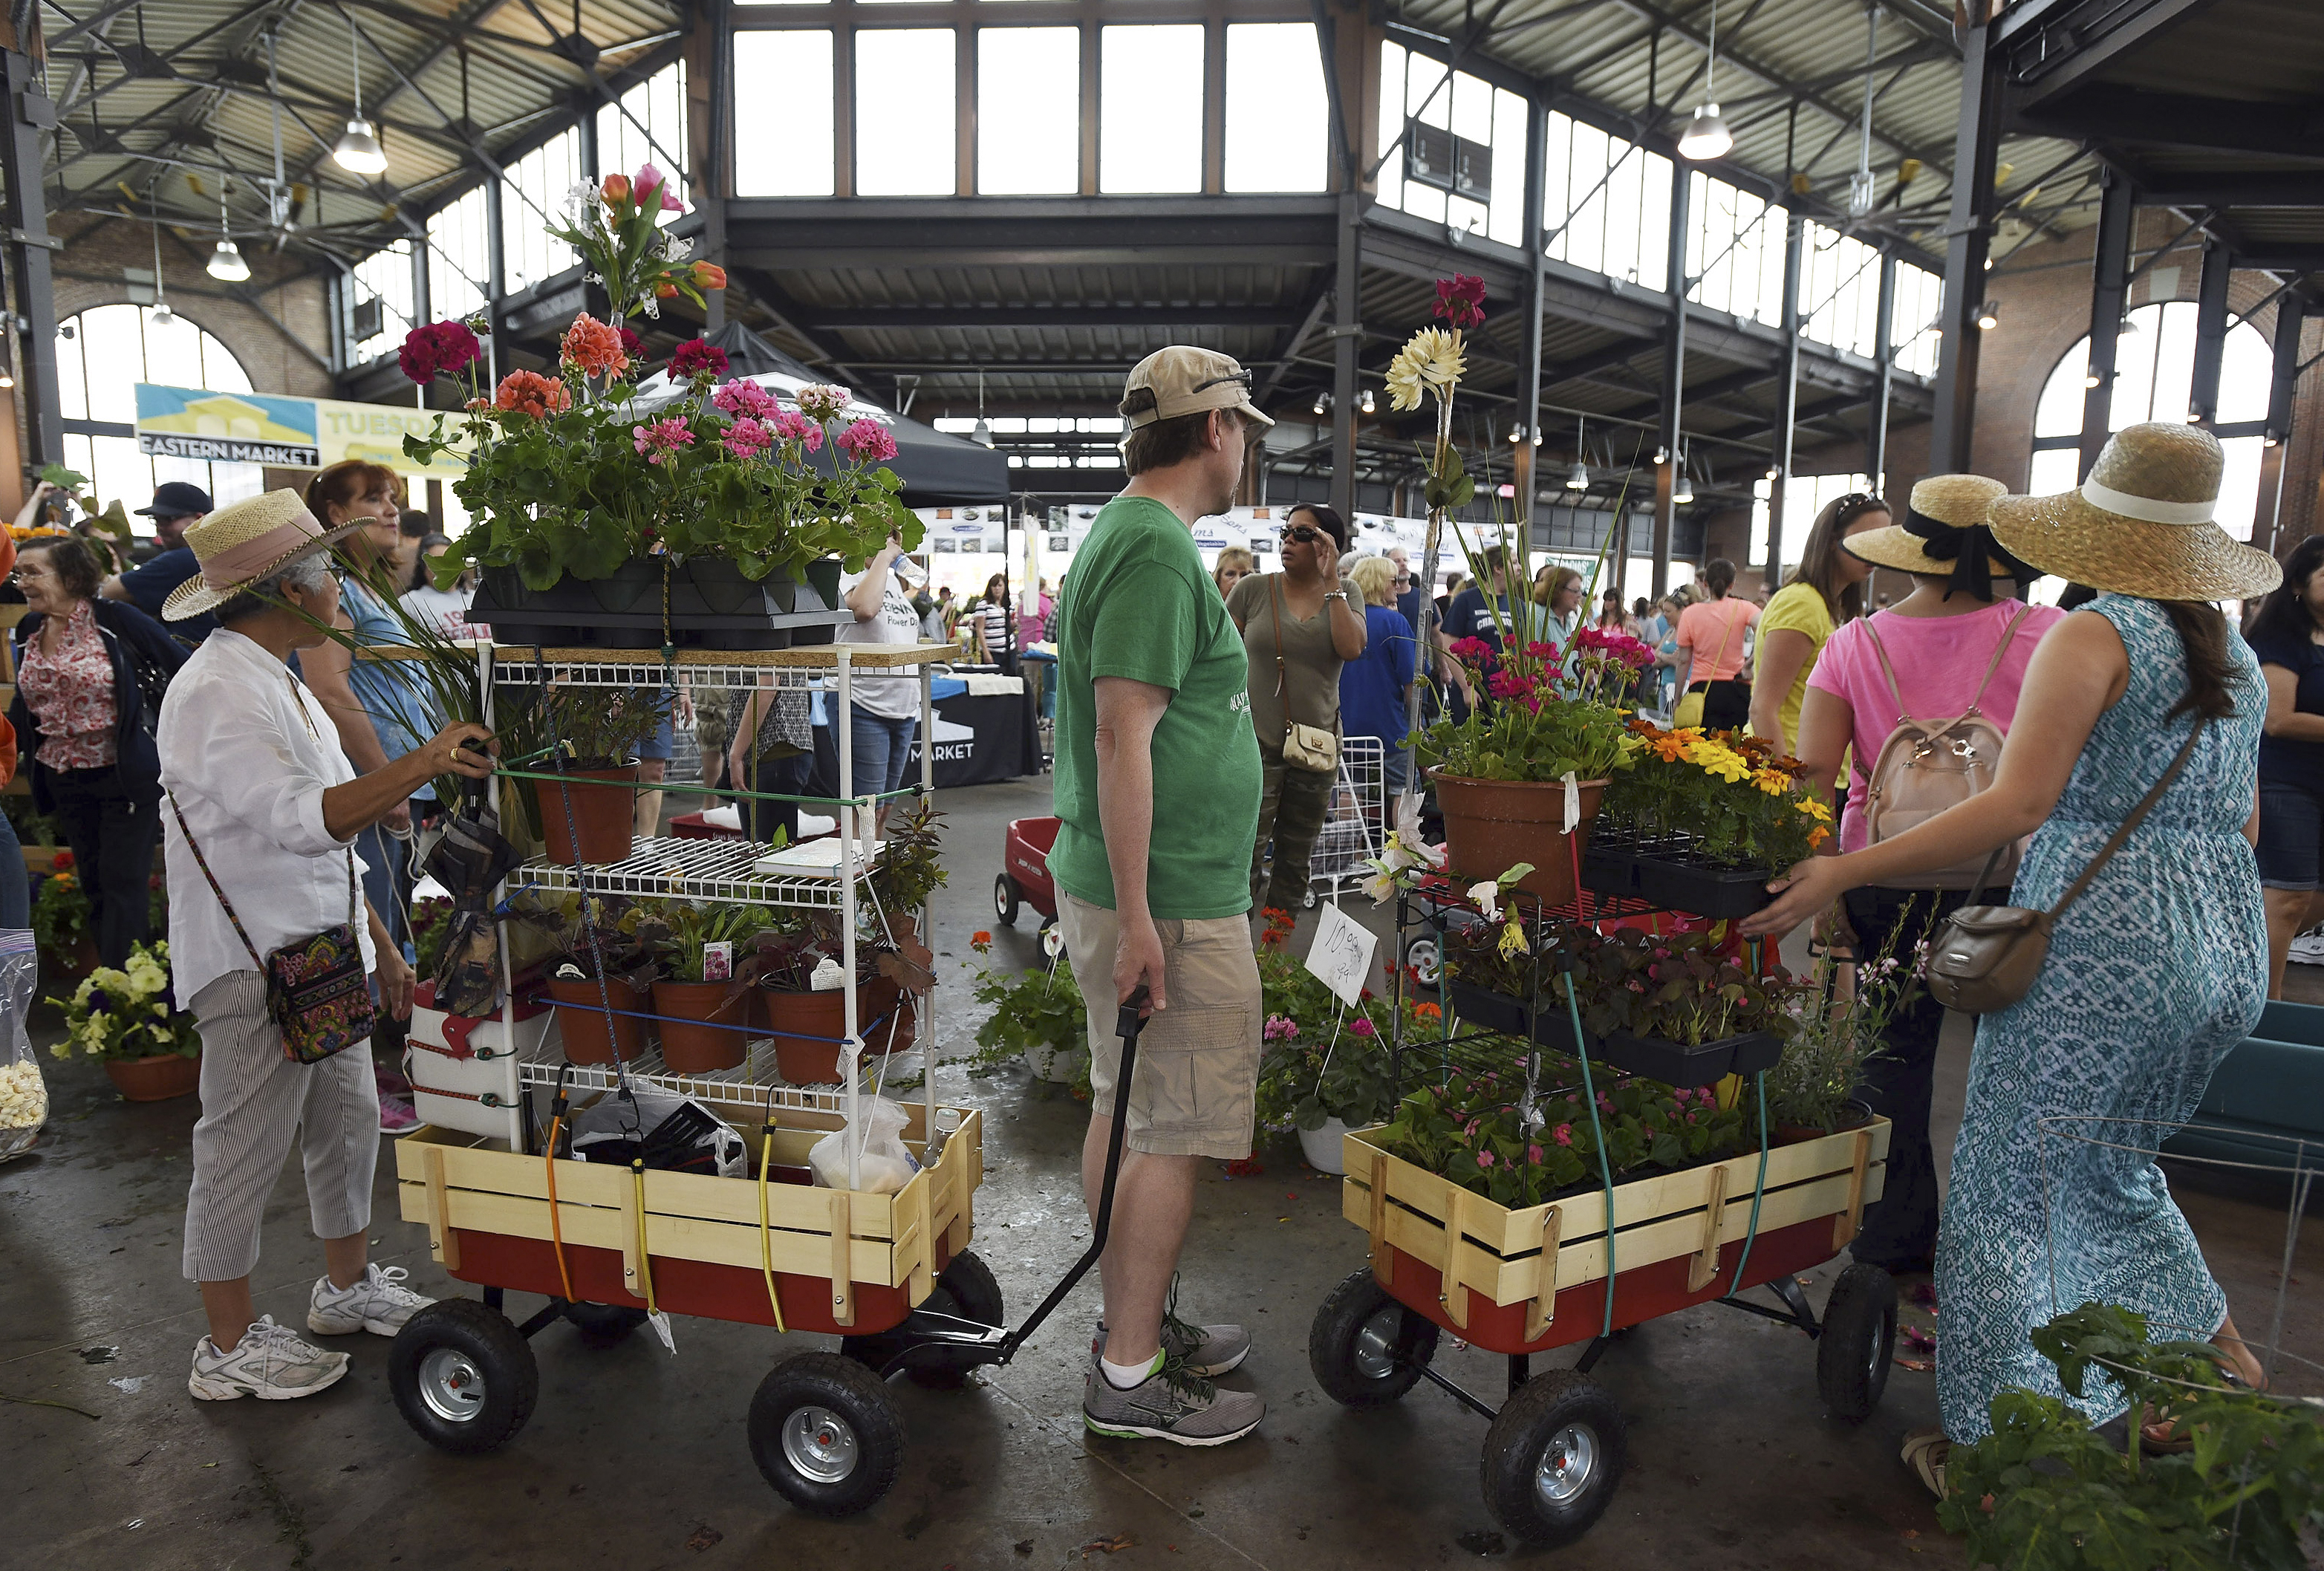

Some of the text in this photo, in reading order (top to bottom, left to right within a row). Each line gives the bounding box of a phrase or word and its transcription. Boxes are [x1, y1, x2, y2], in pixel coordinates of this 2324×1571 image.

[140, 435, 316, 465] EASTERN MARKET
[888, 615, 908, 626] Flower
[911, 743, 974, 762] MRKET
